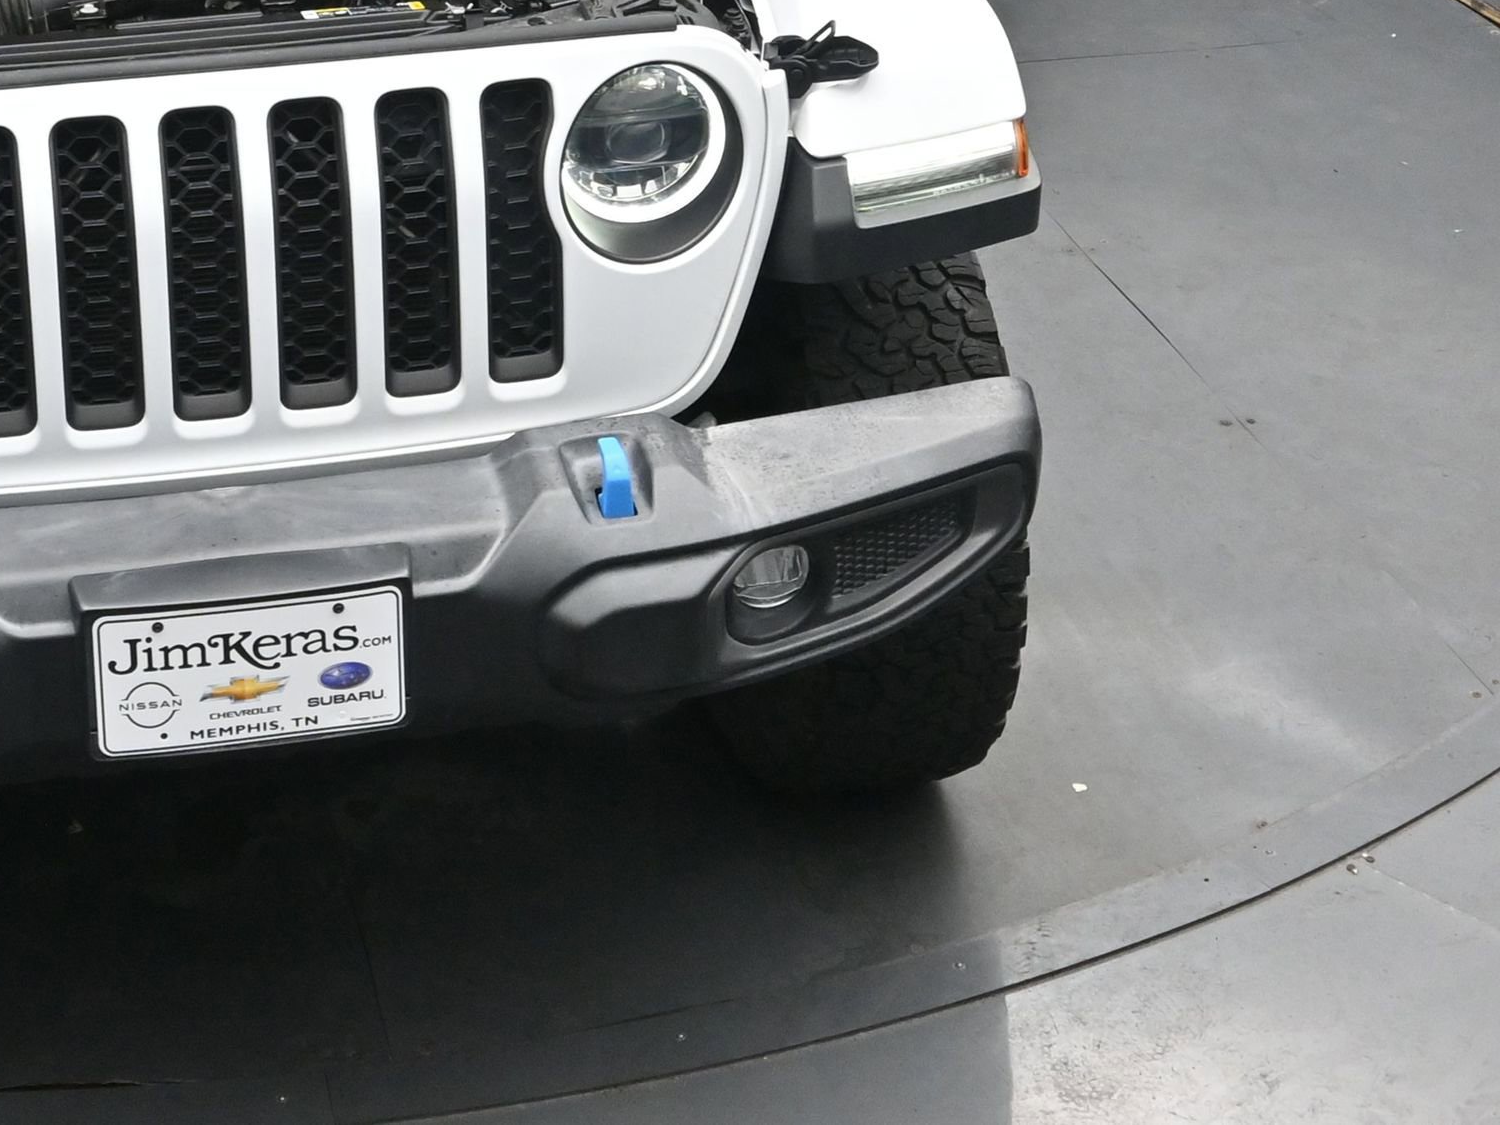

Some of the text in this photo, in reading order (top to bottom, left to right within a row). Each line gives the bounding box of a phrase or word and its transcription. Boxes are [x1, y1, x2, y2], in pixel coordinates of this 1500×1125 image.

[119, 699, 183, 711] NISSAN
[307, 689, 384, 708] SUBARU
[209, 705, 283, 721] CHEVROLET
[190, 715, 319, 740] MEMPHIS, TN
